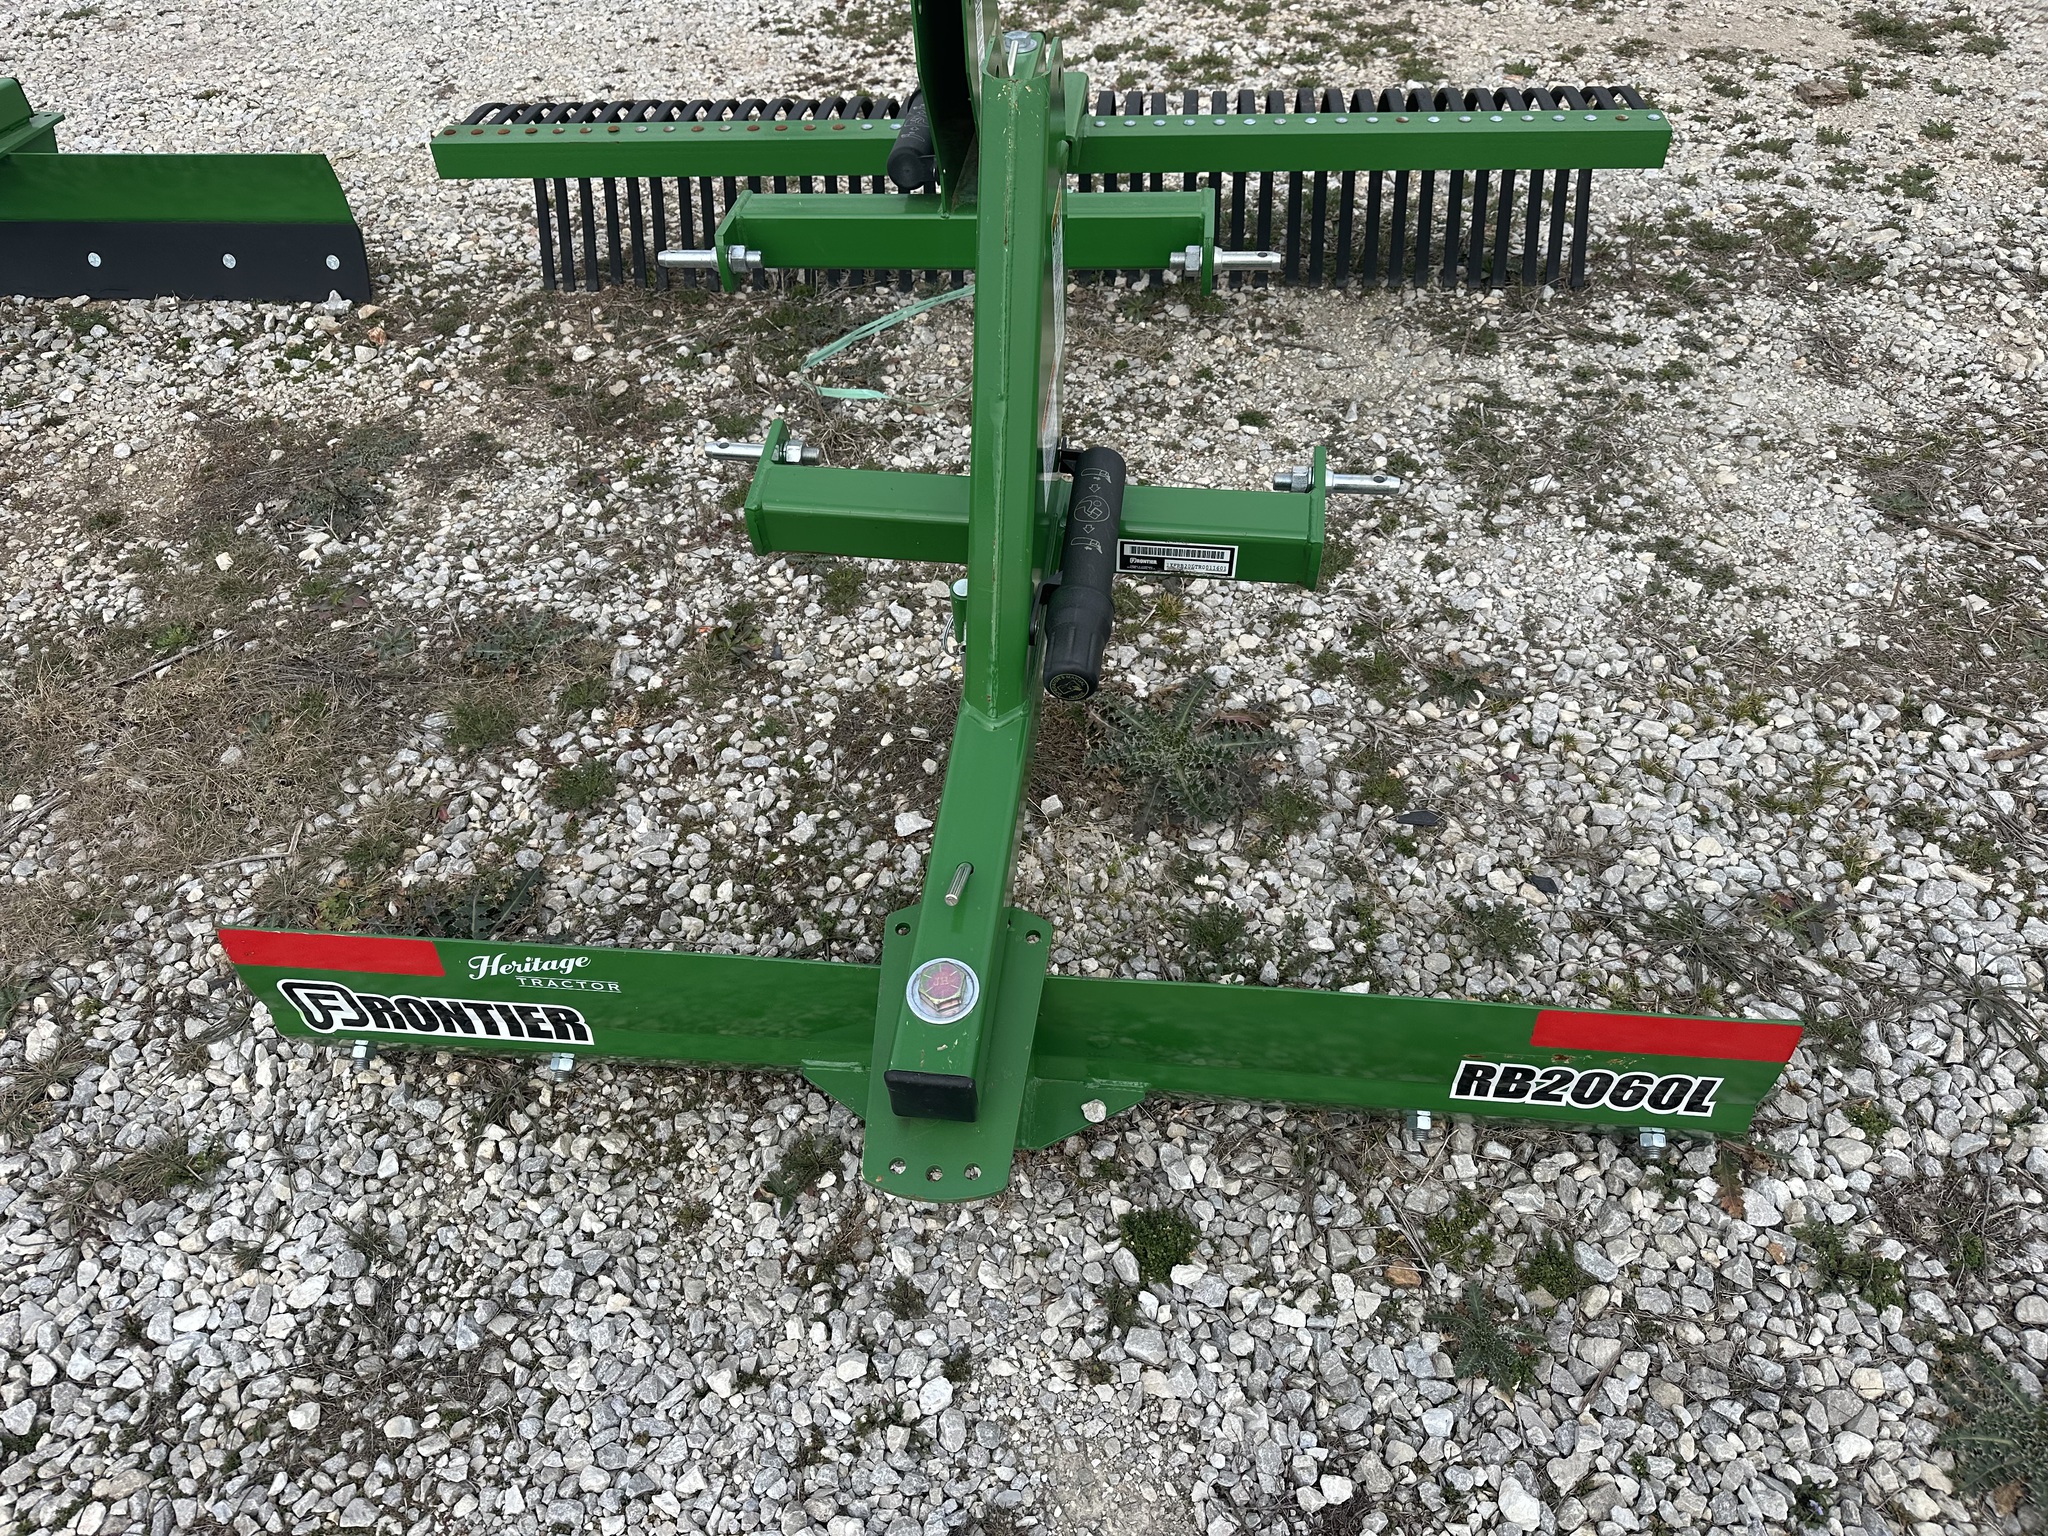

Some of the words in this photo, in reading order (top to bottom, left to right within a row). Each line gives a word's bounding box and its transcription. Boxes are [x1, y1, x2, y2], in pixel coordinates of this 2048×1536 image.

[468, 953, 592, 980] Heritage
[518, 977, 621, 992] TRACTOR
[278, 979, 593, 1044] FRONTIER
[1451, 1061, 1721, 1115] RB2060L
